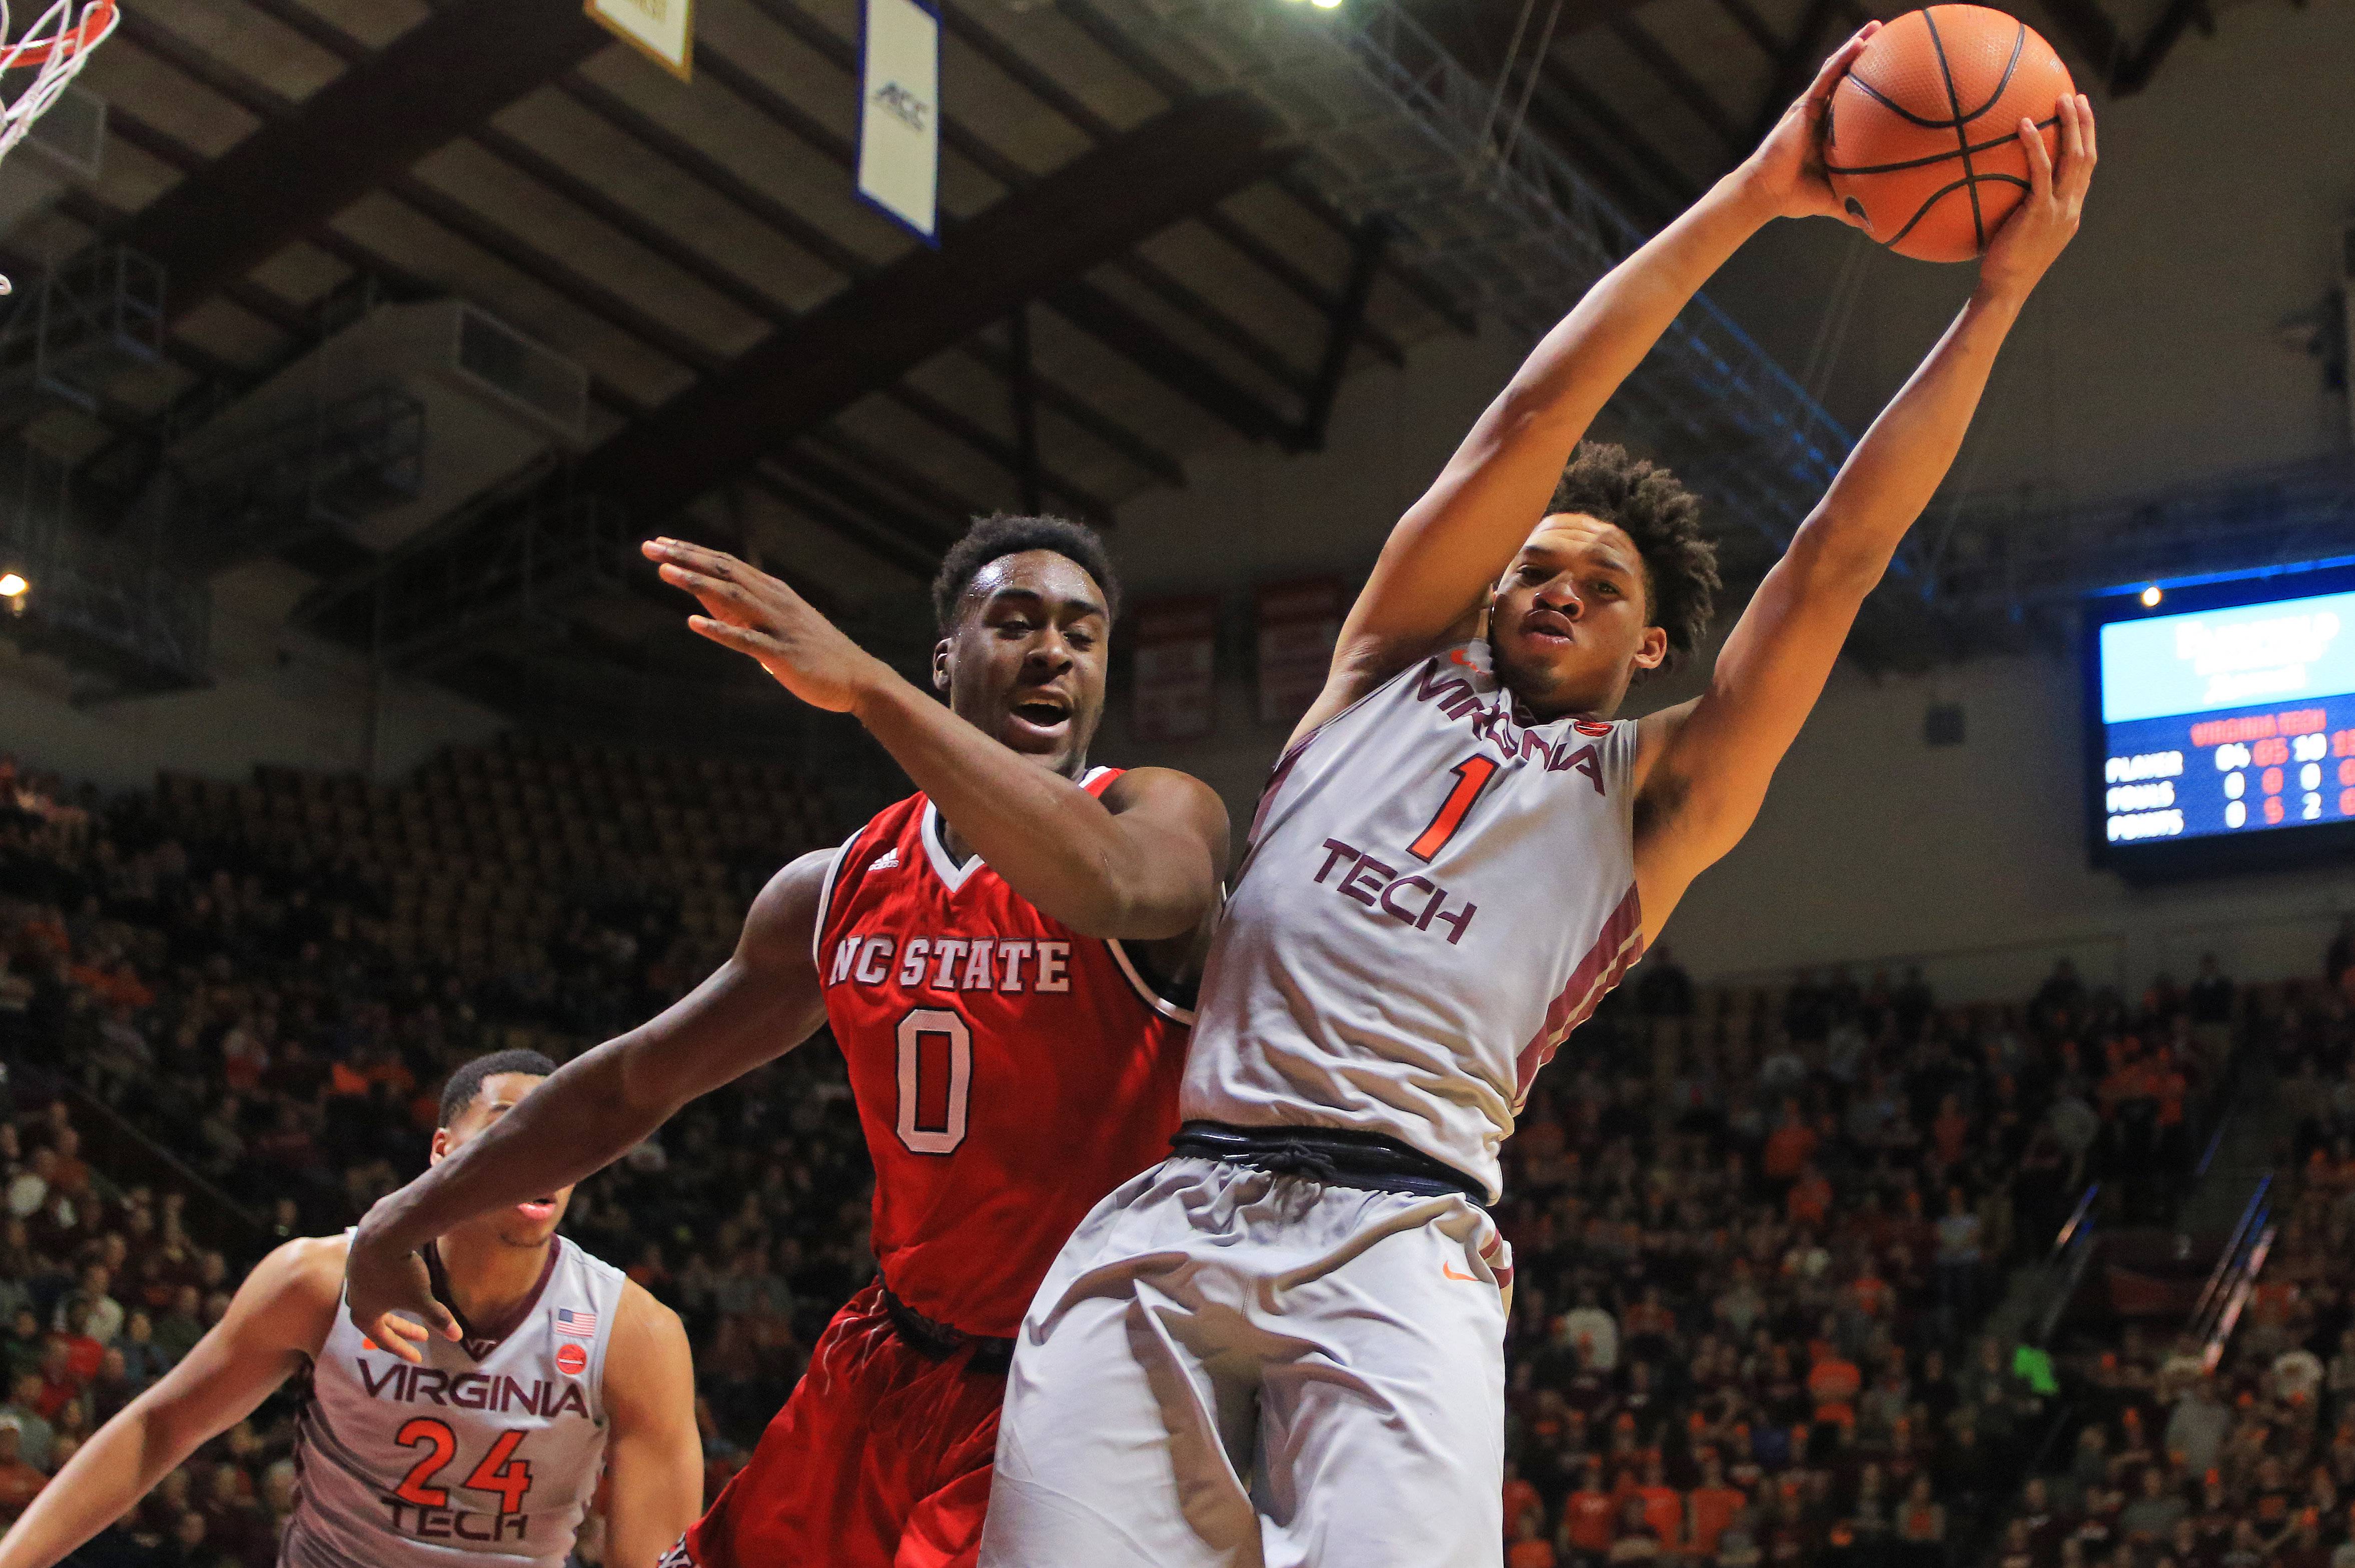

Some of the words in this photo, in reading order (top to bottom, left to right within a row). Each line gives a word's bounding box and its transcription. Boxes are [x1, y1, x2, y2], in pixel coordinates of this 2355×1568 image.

[1417, 656, 1606, 796] VIRGNIA
[1405, 753, 1500, 863] 1
[1313, 838, 1477, 945] TECH
[828, 935, 895, 988] NC
[900, 935, 1071, 994] STATE
[896, 1006, 973, 1154] 0
[356, 1357, 589, 1419] VIRGINIA
[395, 1416, 532, 1514] 24
[381, 1497, 528, 1541] TECH
